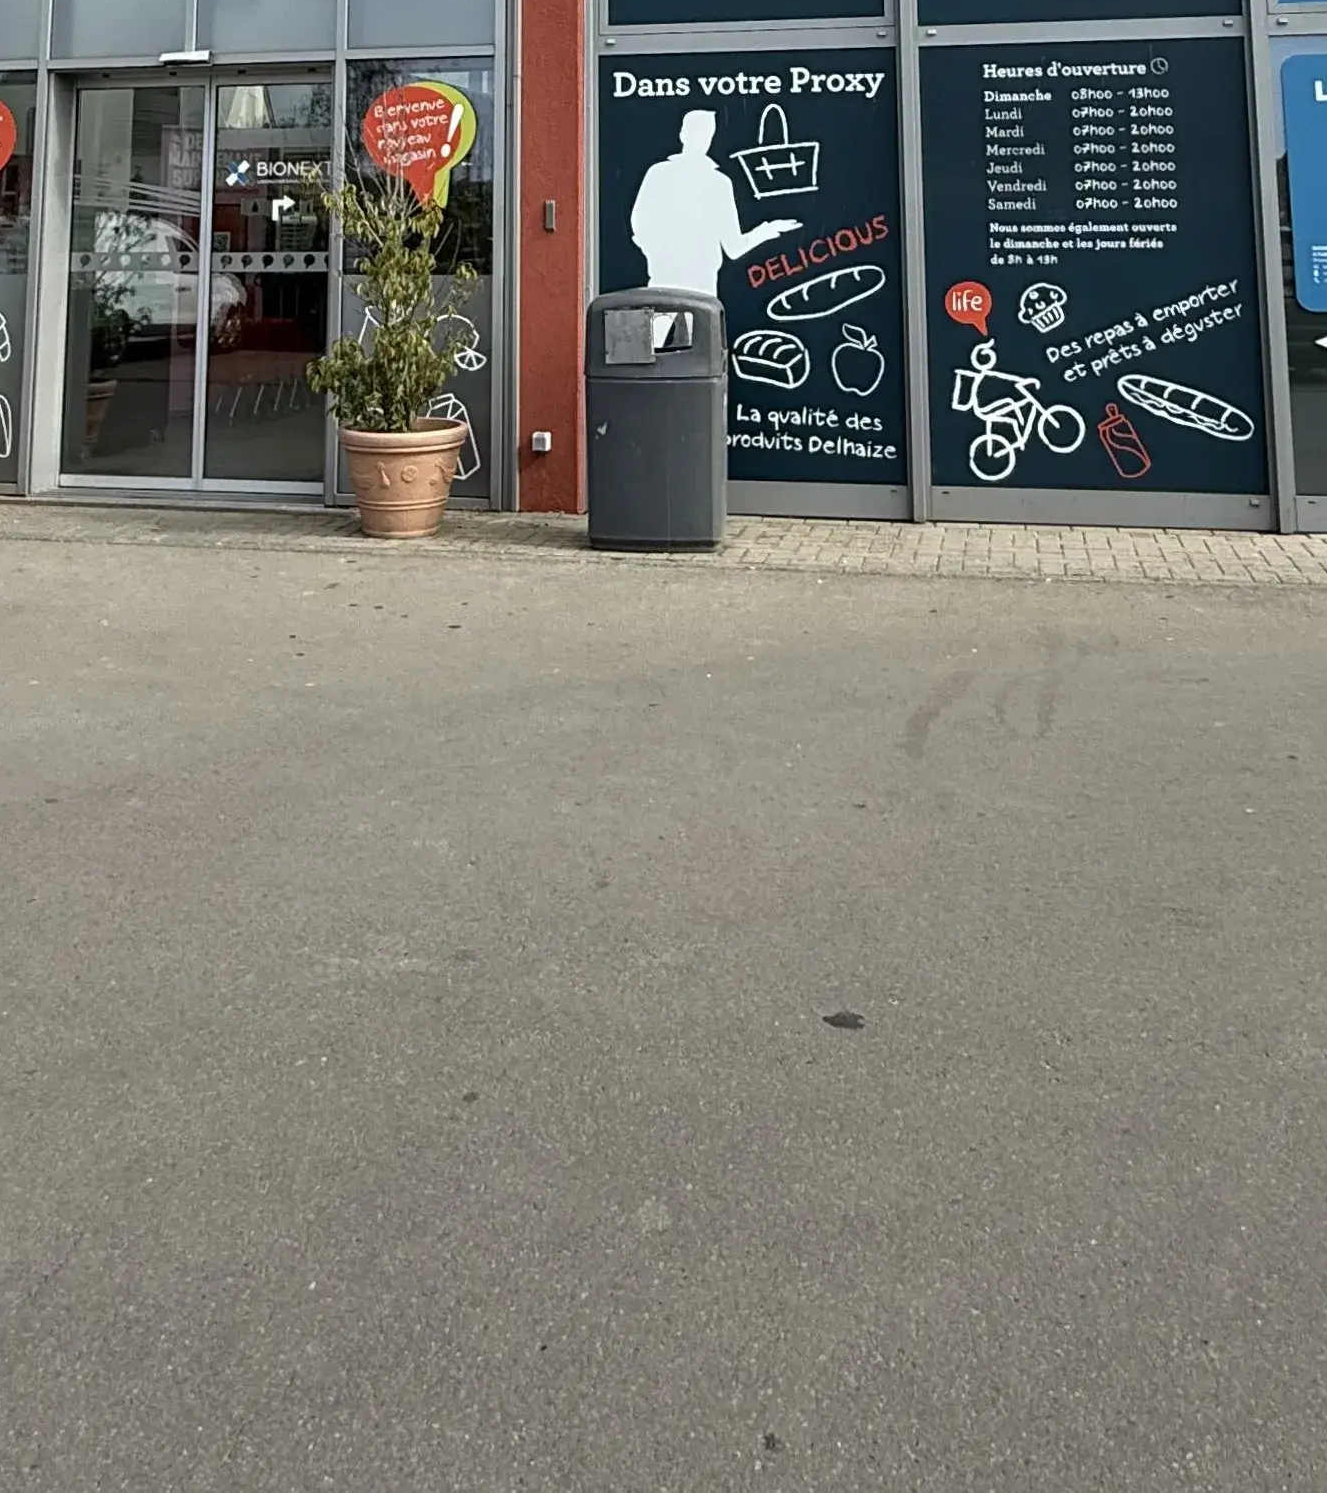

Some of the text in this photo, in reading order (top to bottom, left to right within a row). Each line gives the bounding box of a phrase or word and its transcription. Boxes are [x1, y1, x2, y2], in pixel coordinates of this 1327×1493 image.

[983, 61, 1147, 78] Heures d'ouverture
[613, 67, 885, 98] Dans votre Proxy
[984, 89, 1052, 102] Dimanche
[1071, 88, 1113, 100] 08h00
[1128, 87, 1169, 99] 13h00
[985, 107, 1023, 120] Lundi
[1072, 106, 1114, 118] 07h00
[1130, 105, 1173, 117] 20h00
[410, 113, 449, 128] votre
[985, 125, 1024, 138] Mardi
[1073, 124, 1115, 136] 07h00
[1131, 123, 1174, 135] 20h00
[986, 143, 1045, 156] Mercredi
[1074, 142, 1116, 154] 07h00
[1131, 142, 1175, 154] 20h00
[256, 160, 332, 177] BIONEXT
[986, 162, 1023, 174] Jeudi
[1074, 161, 1116, 172] 07h00
[1132, 160, 1176, 171] 20h00
[987, 179, 1047, 192] Vendredi
[1075, 179, 1117, 190] 07h00
[1133, 178, 1177, 190] 20h00
[988, 197, 1036, 210] Samedi
[1076, 197, 1118, 209] 07h00
[1134, 197, 1178, 208] 20h00
[990, 221, 1177, 234] Nous sommes également ouverts
[747, 214, 889, 288] DELICIOUS
[990, 237, 1164, 250] le dimanche et les jours fériés
[990, 254, 1005, 265] de
[1026, 254, 1034, 265] à
[1037, 254, 1058, 265] 13h
[952, 289, 983, 312] life
[1046, 279, 1239, 364] Des repas à emporter
[1064, 303, 1244, 383] et prêts à déguster
[736, 403, 883, 431] La qualité des
[808, 436, 897, 459] Delhaize
